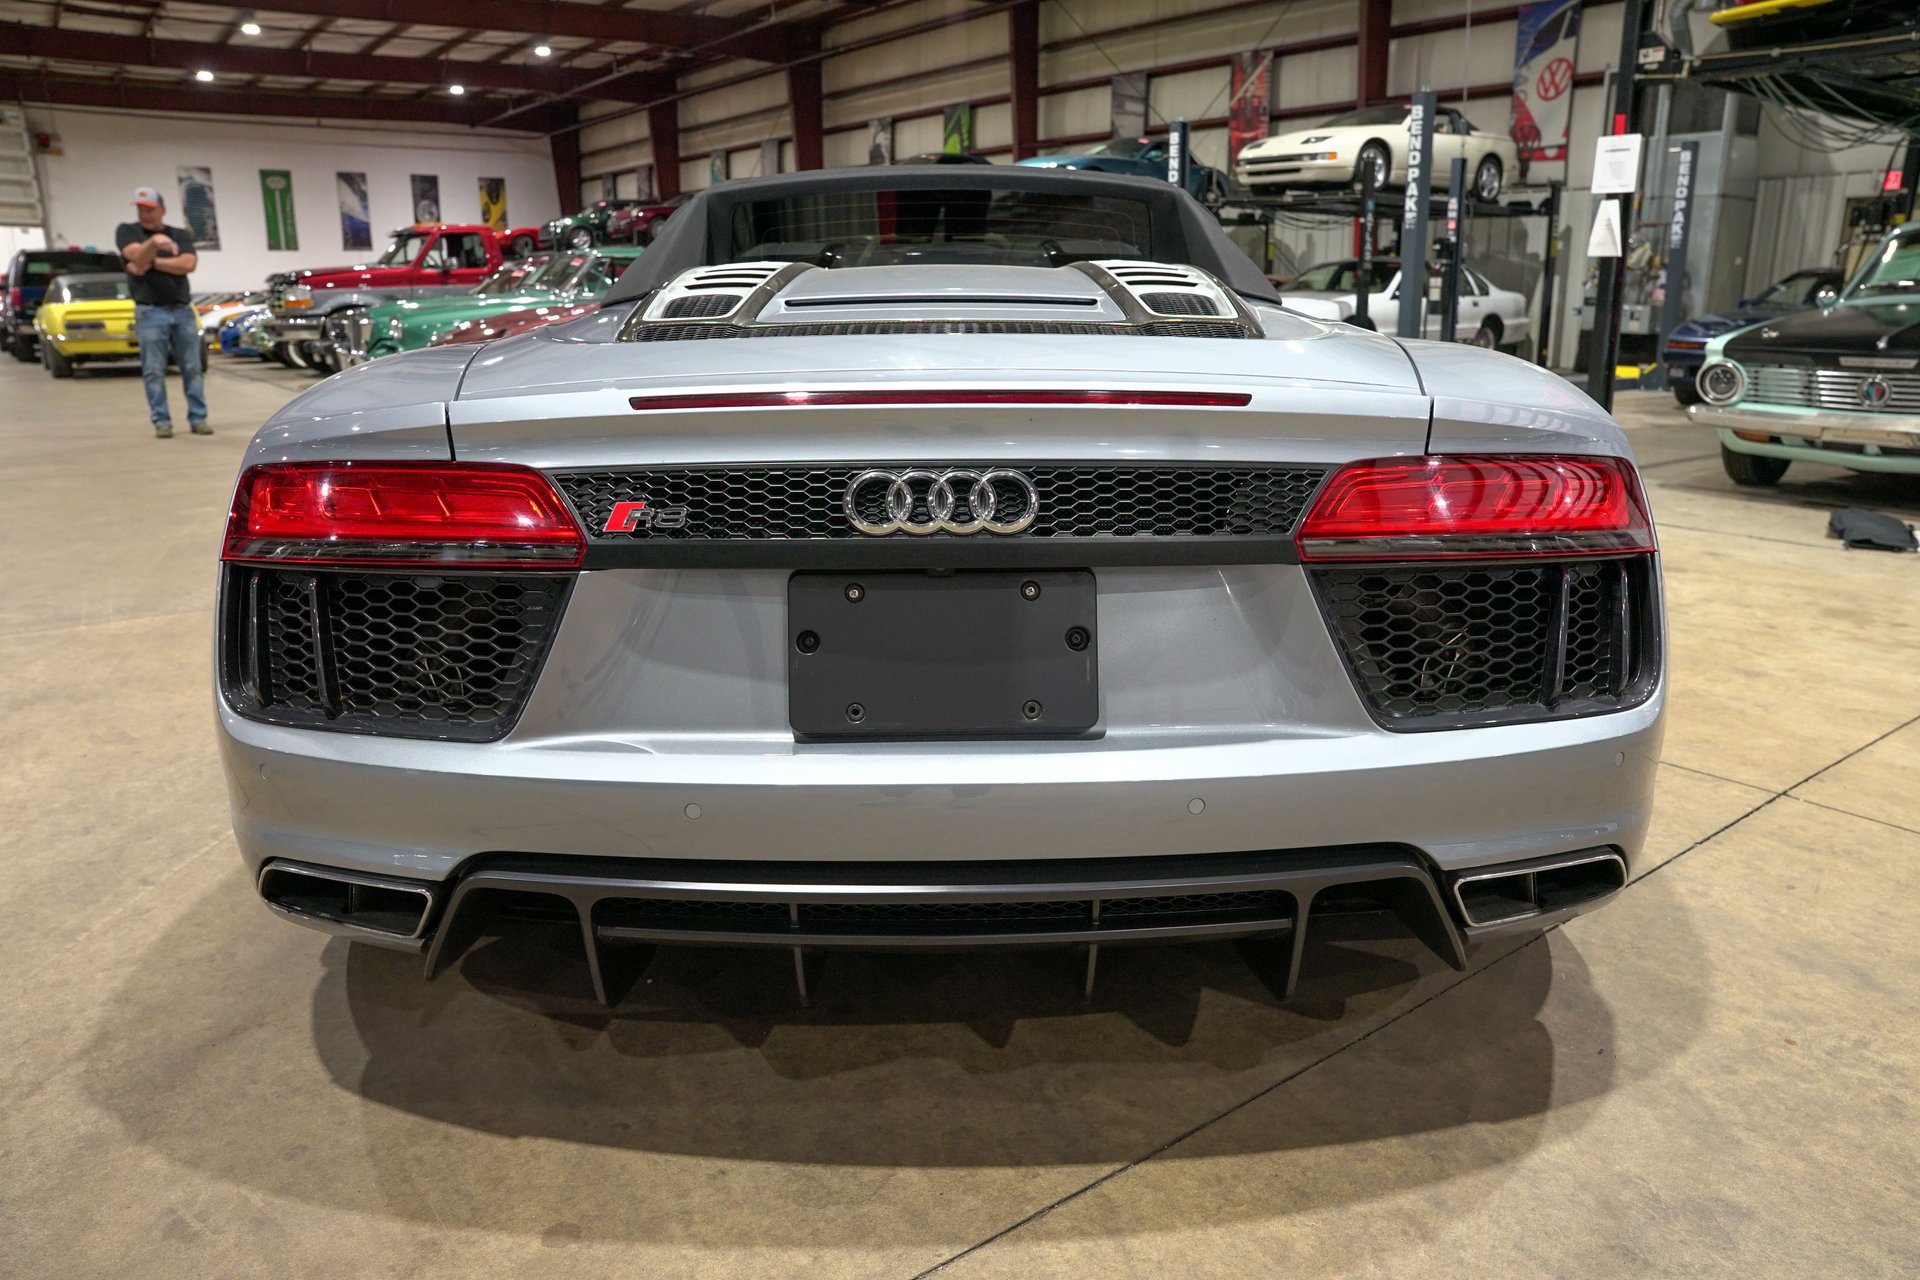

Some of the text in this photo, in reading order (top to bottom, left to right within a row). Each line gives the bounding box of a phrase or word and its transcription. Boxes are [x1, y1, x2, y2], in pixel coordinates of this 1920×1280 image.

[1168, 131, 1180, 187] BEND
[1404, 104, 1424, 211] BENDPAK
[1671, 150, 1692, 236] BENDPAK
[622, 507, 687, 529] R8
